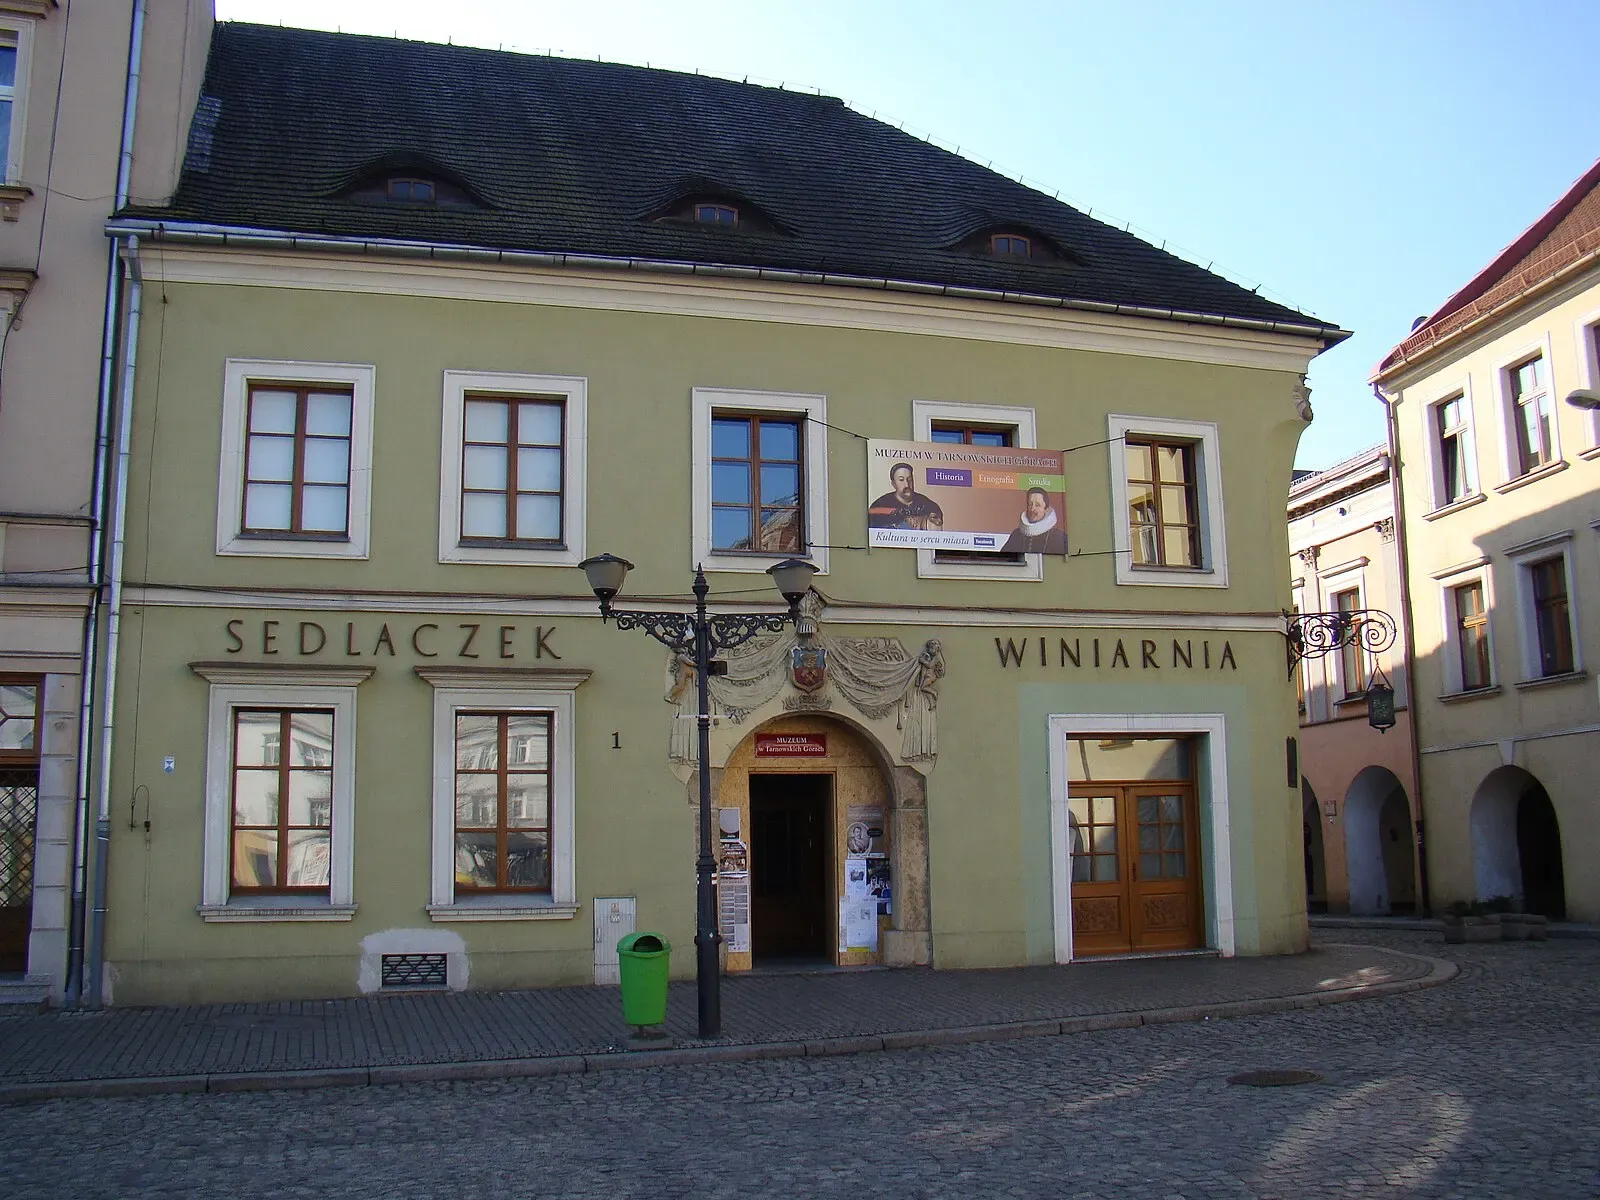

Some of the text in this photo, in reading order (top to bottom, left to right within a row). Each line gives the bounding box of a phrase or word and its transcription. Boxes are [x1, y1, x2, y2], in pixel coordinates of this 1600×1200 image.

[875, 448, 1058, 468] MUZEUM W TARNOWSKICH GÓRACH
[935, 471, 964, 482] Historia
[978, 474, 1014, 485] Etnografia
[1028, 477, 1051, 486] Sztuka
[875, 531, 907, 542] Kultura
[920, 536, 940, 544] sercu
[942, 536, 969, 545] miasta
[226, 619, 562, 660] SEDLACZEK
[994, 636, 1238, 671] WINIARNIA
[612, 731, 622, 750] 1
